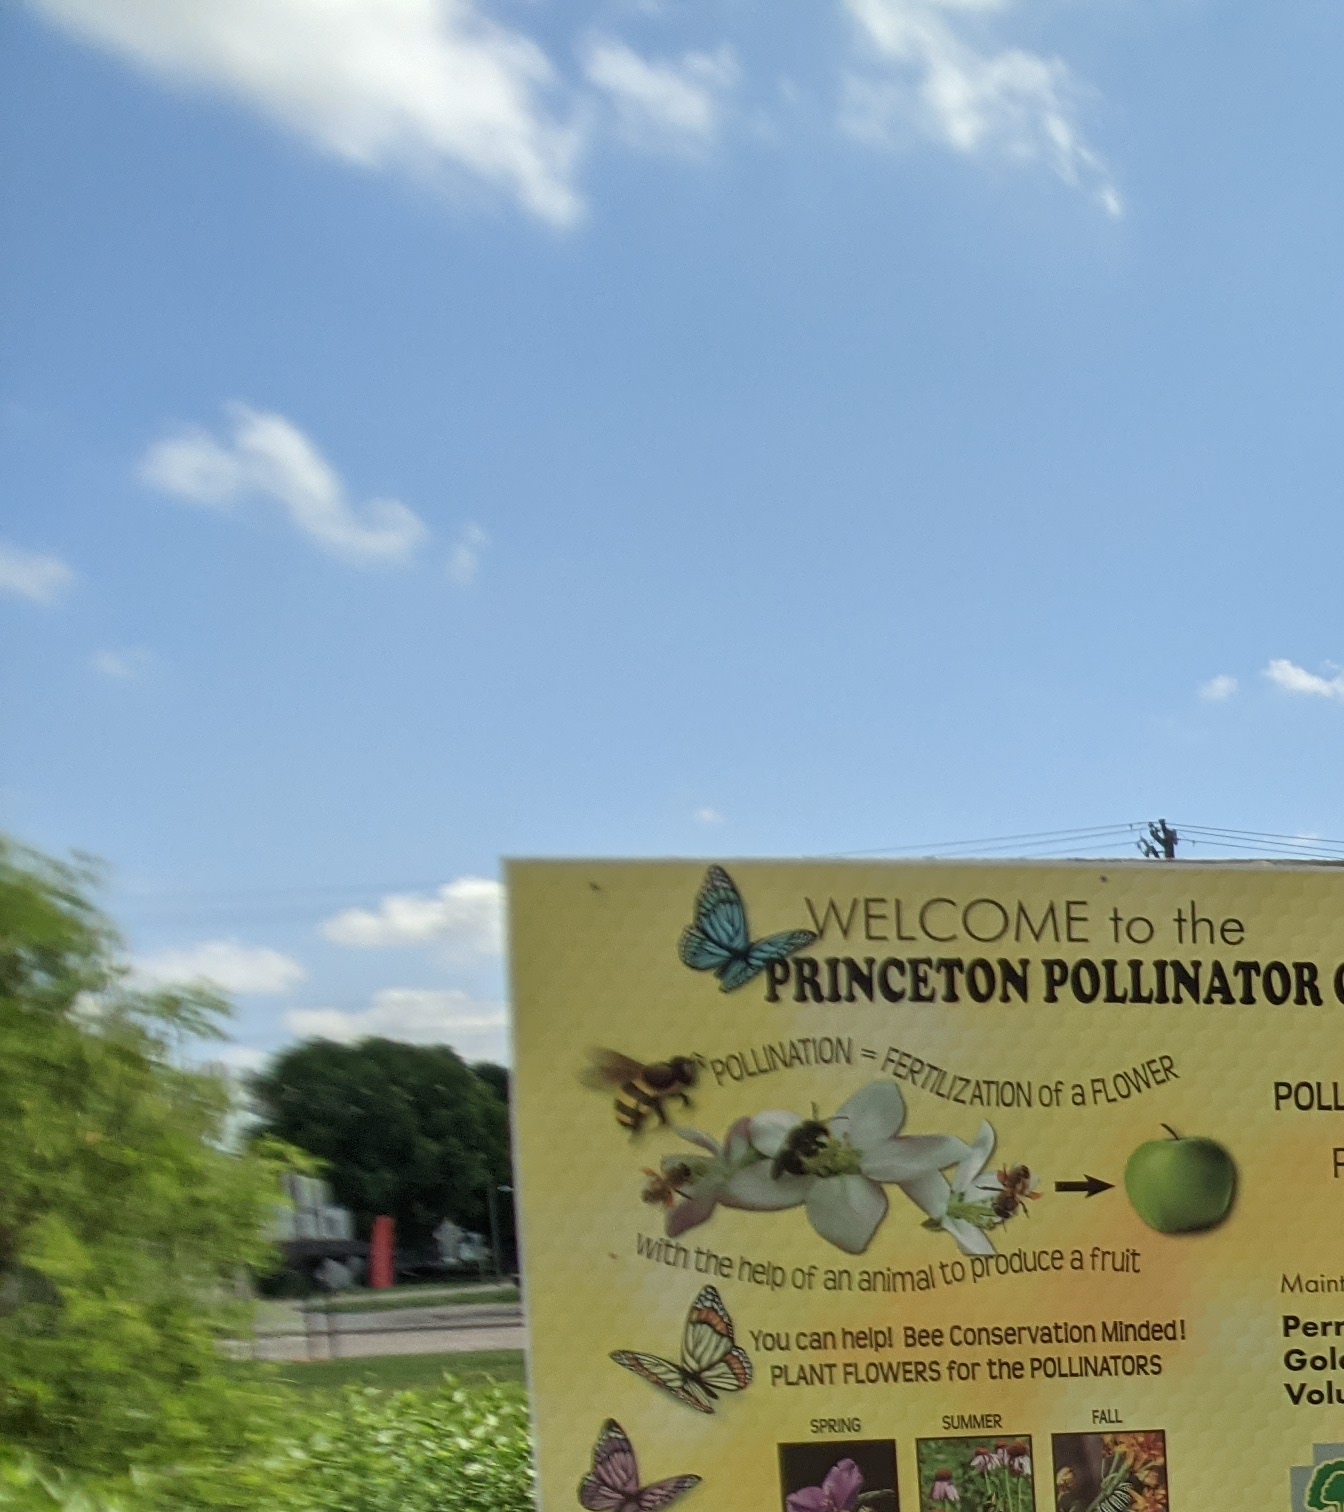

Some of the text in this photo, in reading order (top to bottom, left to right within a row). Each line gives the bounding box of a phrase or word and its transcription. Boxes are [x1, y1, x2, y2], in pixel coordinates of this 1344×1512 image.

[804, 897, 1245, 946] WELCOME to the
[763, 956, 1030, 1004] PRINCETON
[1041, 958, 1324, 1007] POLLINATOR
[710, 1036, 854, 1086] POLLINATION
[880, 1046, 1032, 1108] FERTILIZATION
[1038, 1080, 1064, 1108] of
[1071, 1084, 1087, 1107] a
[1091, 1053, 1181, 1105] FLOWER
[694, 1246, 733, 1278] the
[737, 1255, 787, 1291] help
[791, 1265, 819, 1290] of
[823, 1268, 853, 1291] an
[858, 1264, 936, 1293] animal
[940, 1260, 965, 1286] to
[971, 1247, 1064, 1283] produce
[1070, 1249, 1084, 1271] a
[1090, 1246, 1141, 1273] fruit
[749, 1329, 790, 1352] You
[795, 1330, 837, 1351] can
[841, 1326, 894, 1353] help!
[903, 1325, 945, 1348] Bee
[949, 1321, 1097, 1346] Conservation
[770, 1354, 1163, 1387] PLANT FLOWERS for the POLLINATORS
[809, 1417, 863, 1434] SPRING
[941, 1413, 1003, 1431] SUMMER
[1091, 1408, 1124, 1425] FALL
